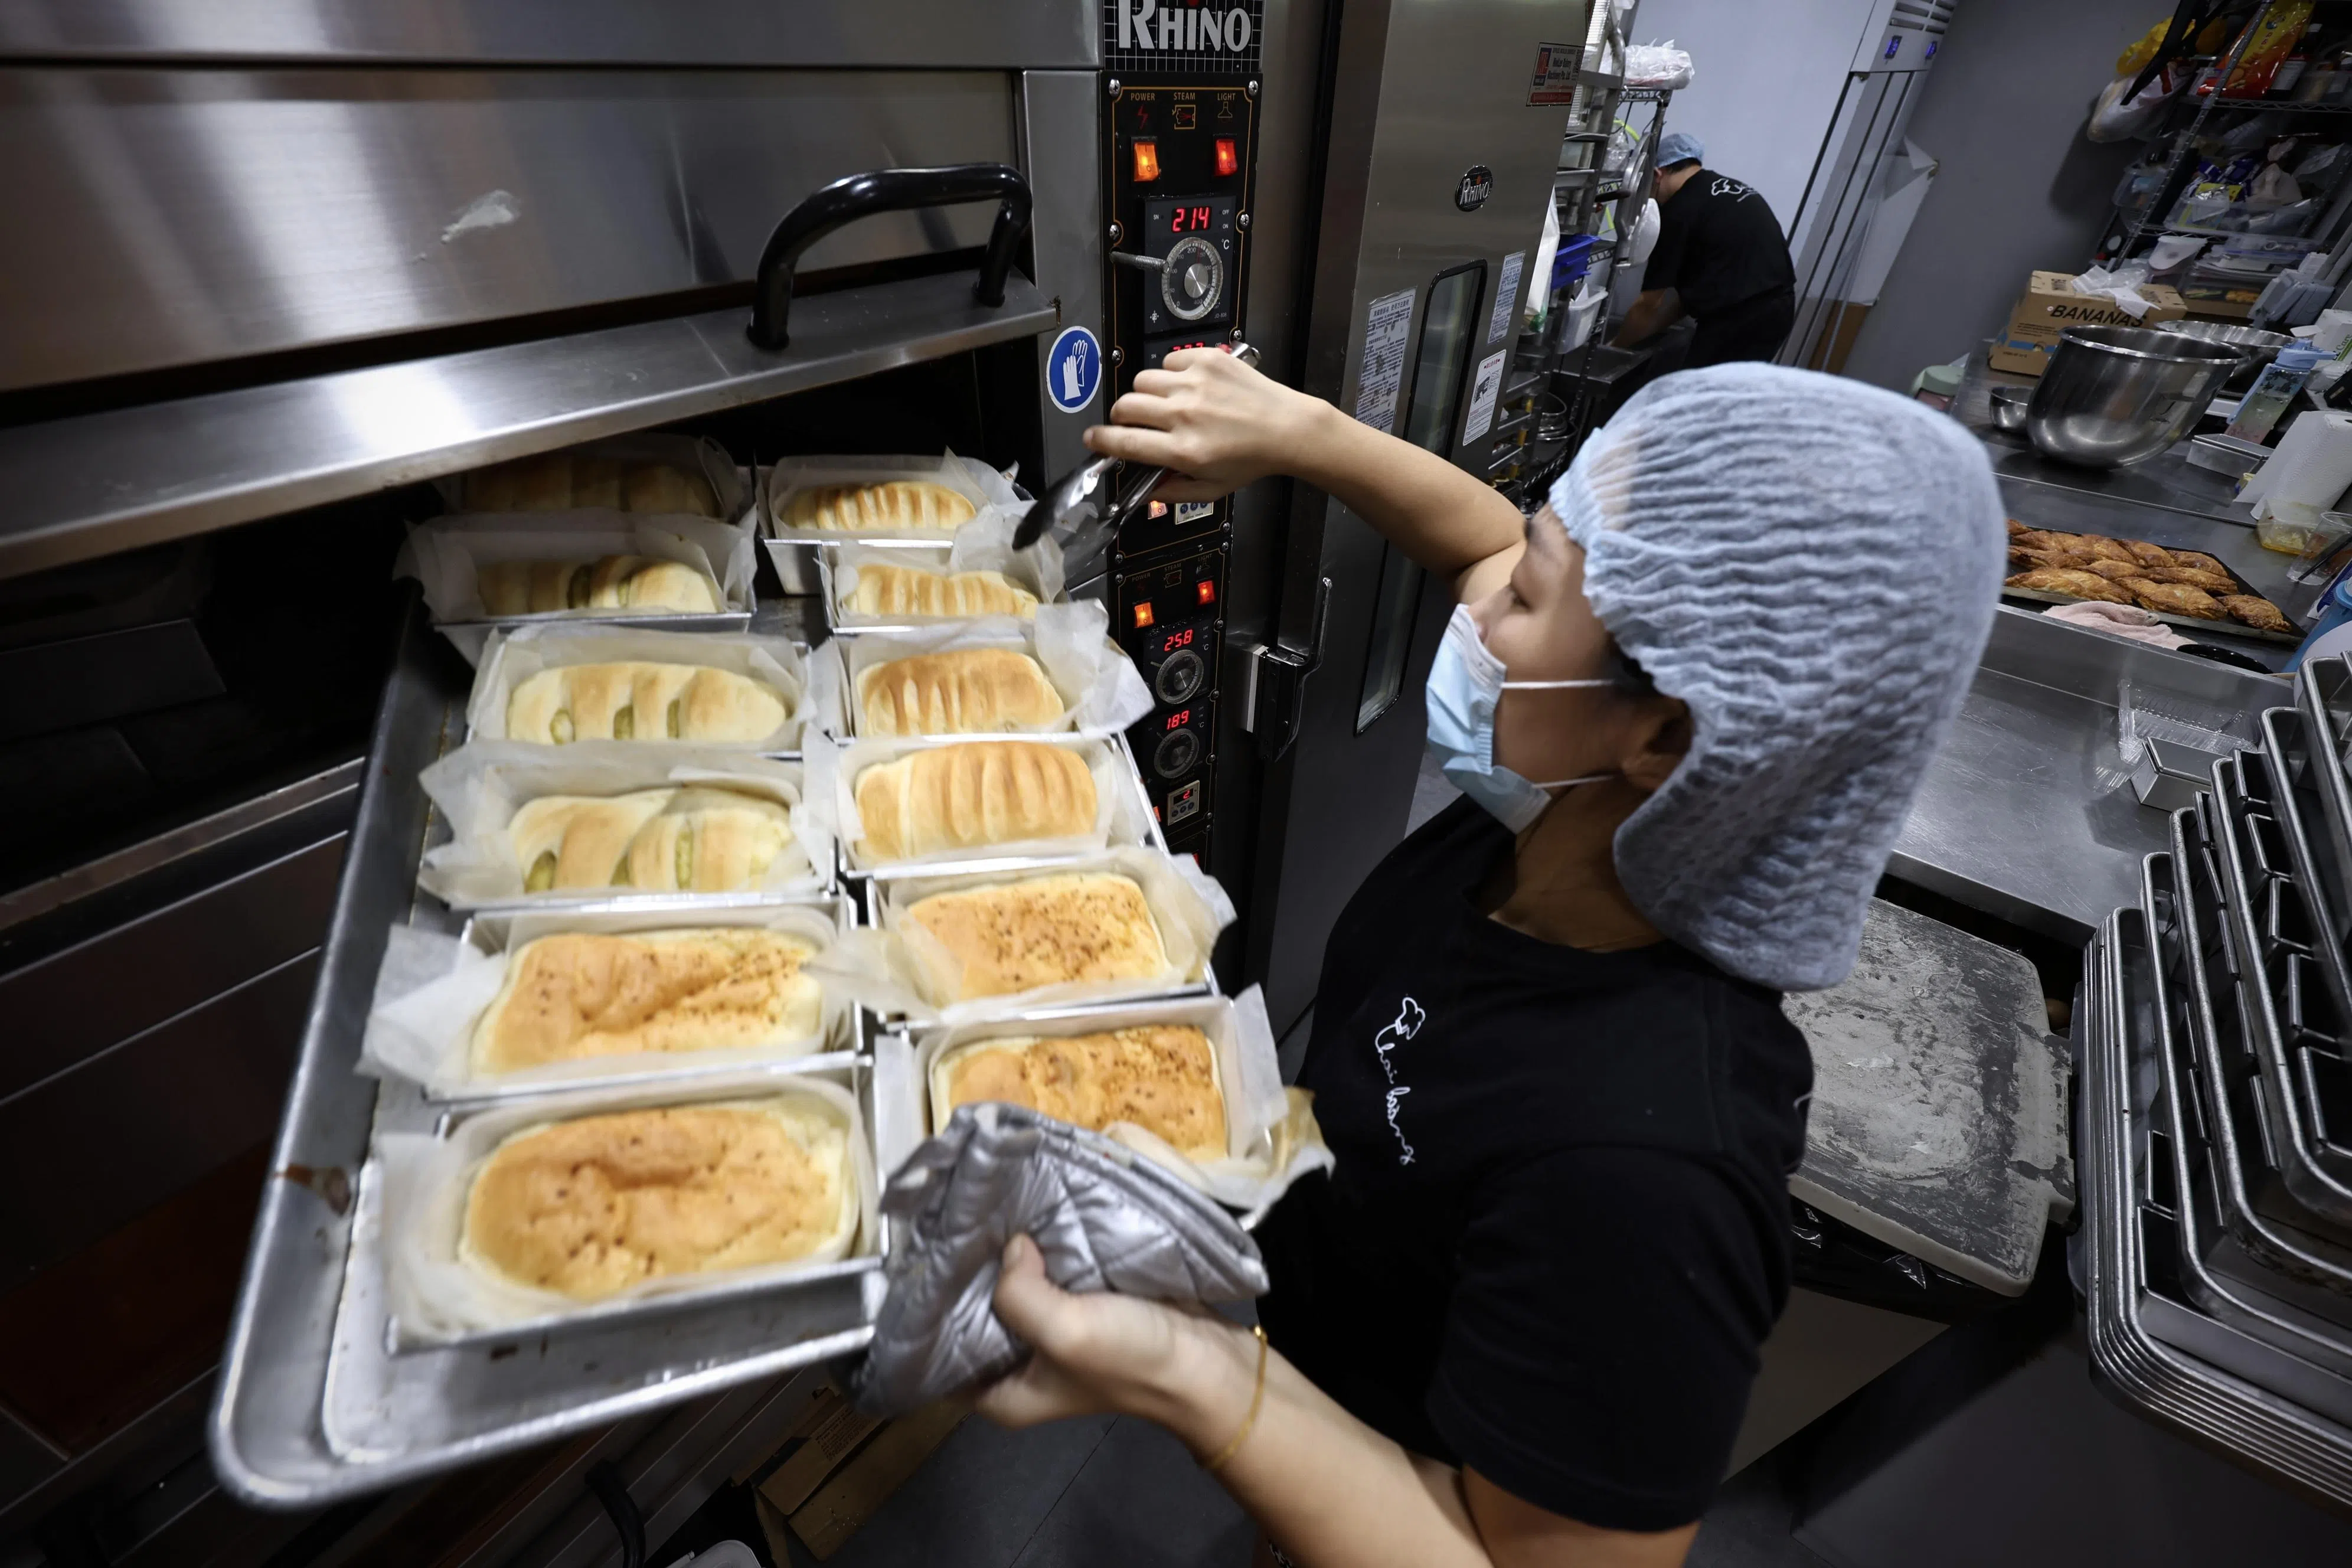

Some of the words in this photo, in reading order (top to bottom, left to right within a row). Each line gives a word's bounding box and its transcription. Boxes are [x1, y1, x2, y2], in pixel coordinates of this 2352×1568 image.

[1118, 0, 1251, 52] RHINO
[1459, 178, 1489, 205] RHINO
[1172, 207, 1210, 231] 214
[2050, 305, 2147, 328] BANANAS
[1132, 572, 1151, 582] POWER
[1164, 563, 1181, 571] STEAM
[1164, 629, 1193, 651] 258
[1166, 710, 1190, 730] 189
